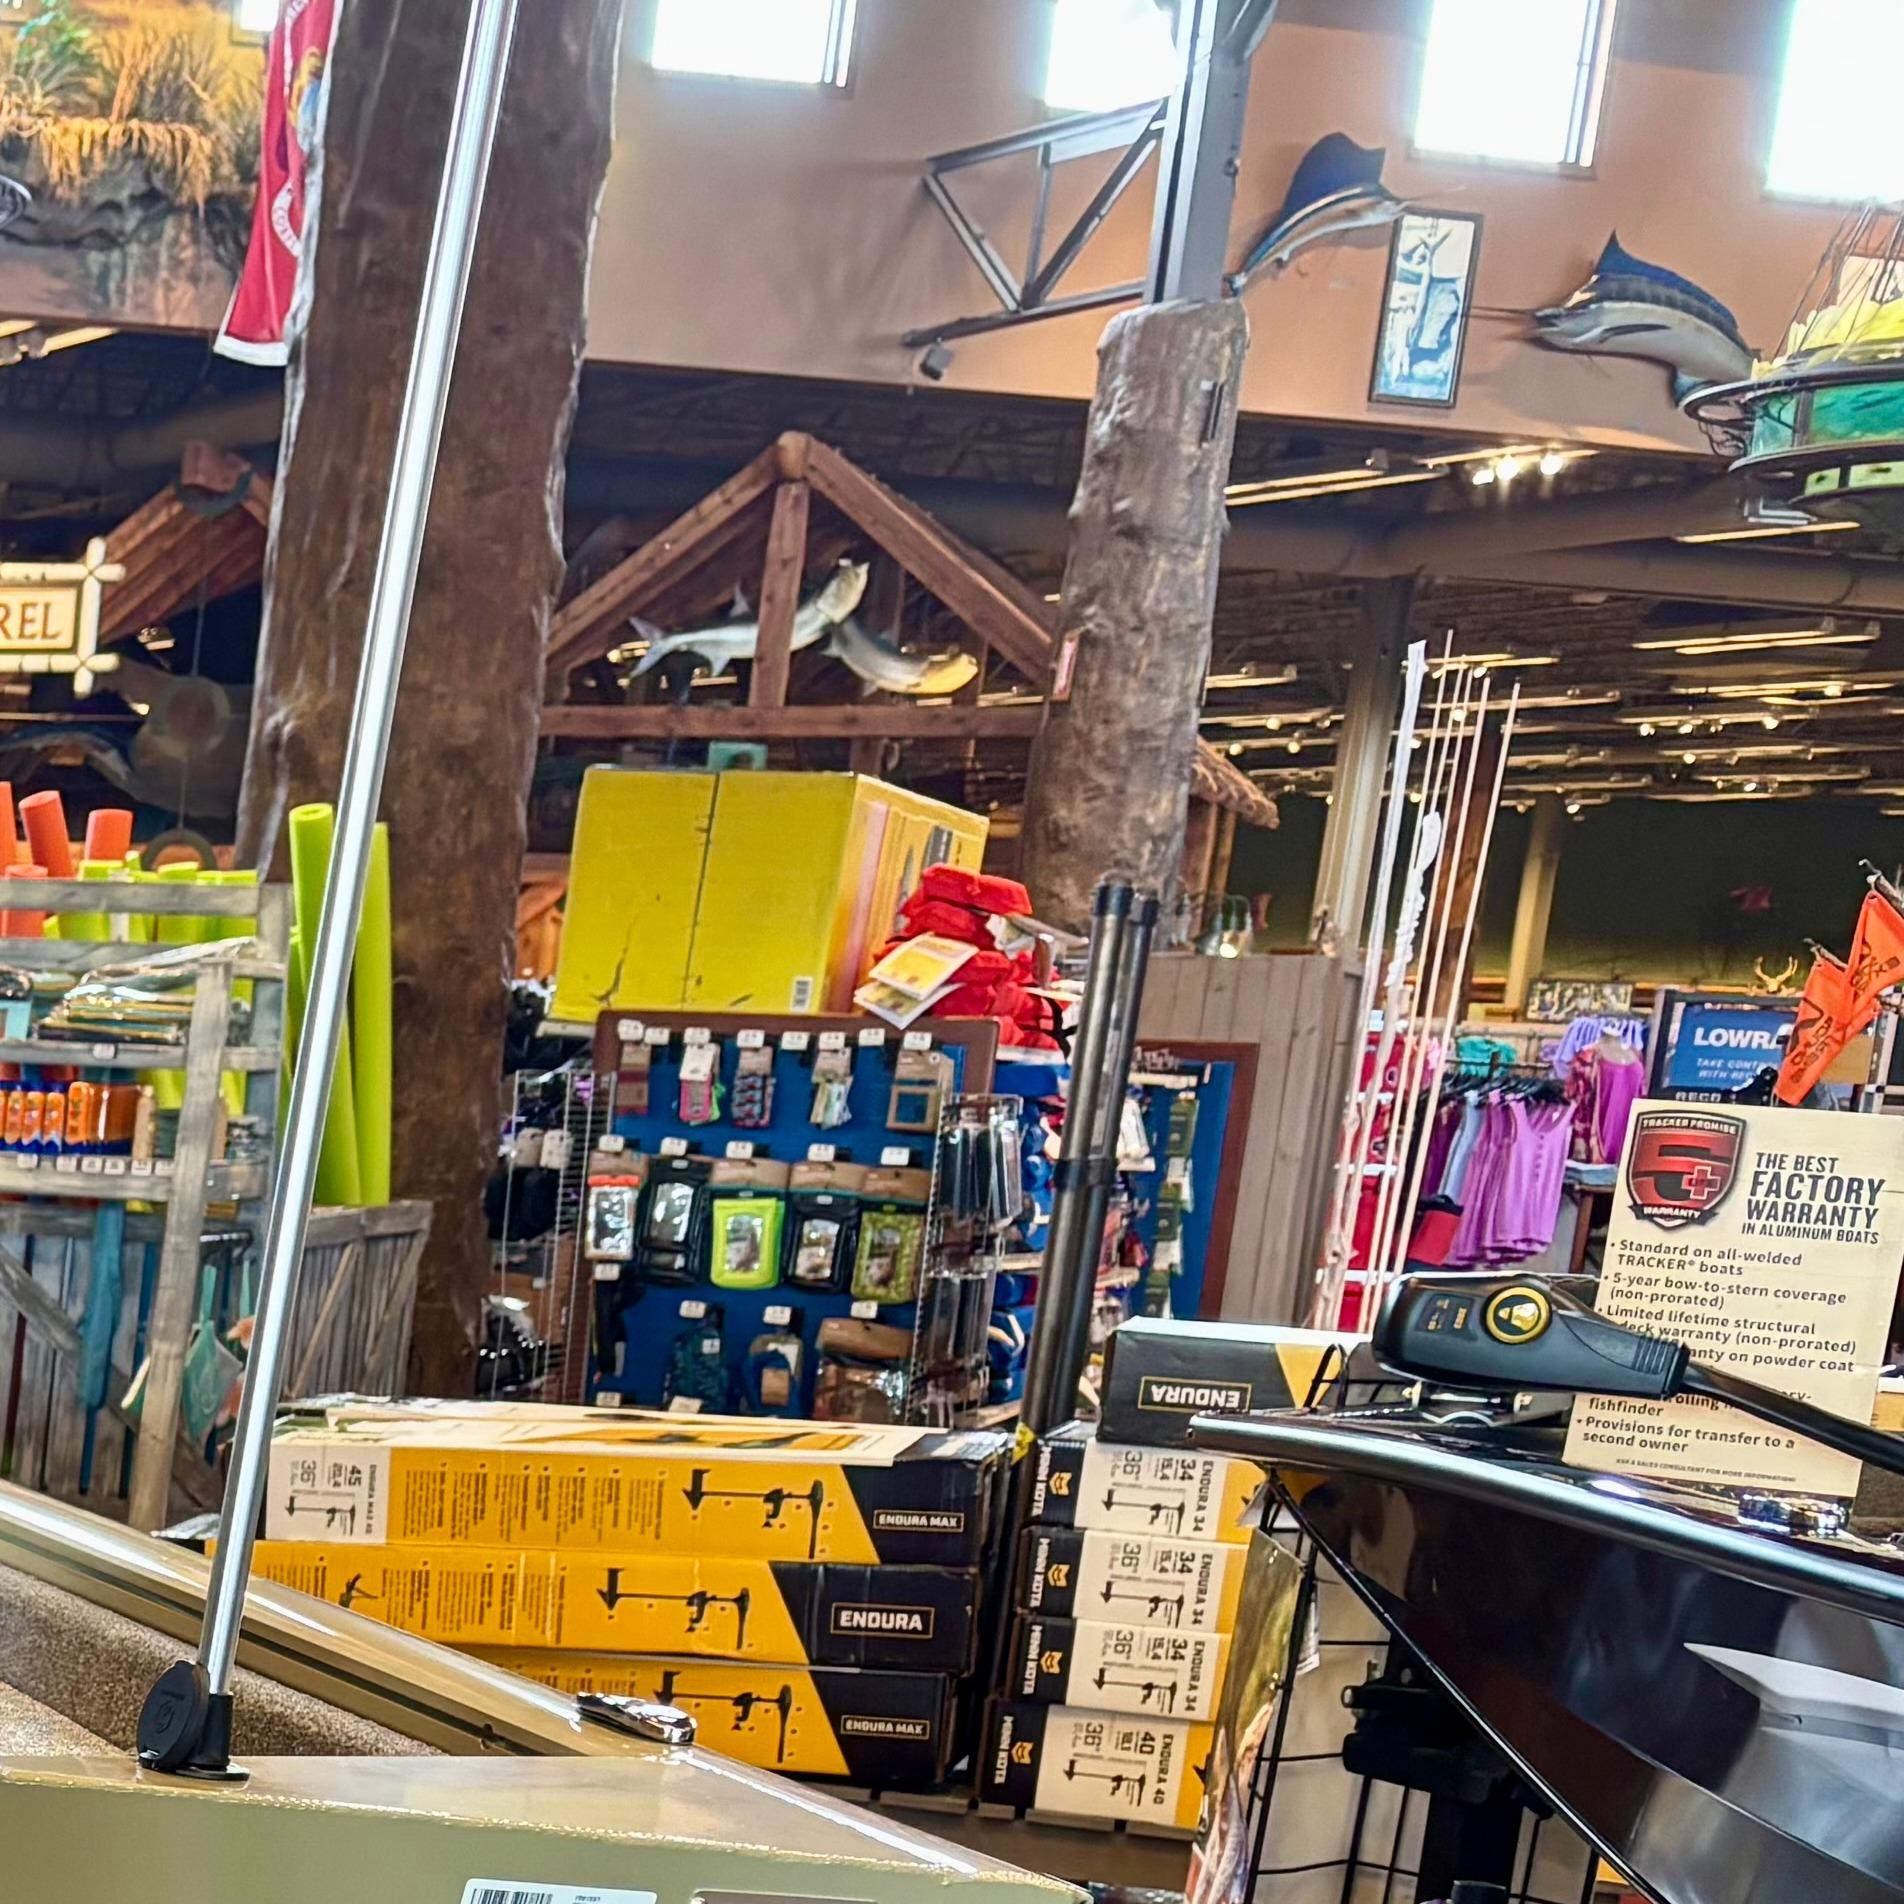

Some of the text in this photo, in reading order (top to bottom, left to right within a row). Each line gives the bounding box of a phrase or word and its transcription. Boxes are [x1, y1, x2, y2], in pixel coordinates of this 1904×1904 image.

[1693, 1026, 1794, 1050] LOWRA
[1755, 1152, 1839, 1173] THE BEST
[1750, 1171, 1886, 1207] FACTORY
[1643, 1206, 1701, 1219] WARRANTY
[1747, 1201, 1880, 1230] WARRANTY
[1742, 1223, 1880, 1245] IN ALUMINUM BOATS
[1619, 1239, 1803, 1267] Standard on all-welded
[1699, 1260, 1744, 1276] boats
[1610, 1287, 1725, 1310] (non-prorated)
[1613, 1272, 1847, 1306] 5-year bow-to-stern coverage
[1607, 1304, 1816, 1336] Limited lifetime structural
[1658, 1326, 1732, 1345] warranty
[1735, 1332, 1857, 1355] (non-prorated)
[1729, 1351, 1749, 1363] on
[1753, 1353, 1816, 1370] powder
[1819, 1359, 1855, 1373] coat
[1150, 1384, 1241, 1409] ENDURA
[1588, 1397, 1665, 1418] fishfinder
[1582, 1432, 1689, 1453] second owner
[1585, 1416, 1795, 1450] Provisions for transfer to a
[348, 1464, 362, 1487] 45
[1178, 1458, 1197, 1481] 34
[1192, 1460, 1214, 1532] ENDURA 34
[878, 1514, 958, 1528] ENDURA MAX
[1177, 1552, 1196, 1575] 34
[1191, 1554, 1213, 1625] ENDURA 34
[839, 1610, 923, 1632] ENDURA
[1170, 1638, 1188, 1662] 34
[1185, 1640, 1206, 1712] ENDURA 34
[845, 1719, 924, 1735] ENDURA MAX
[1139, 1731, 1156, 1755] 40
[1157, 1734, 1174, 1784] ENDURA
